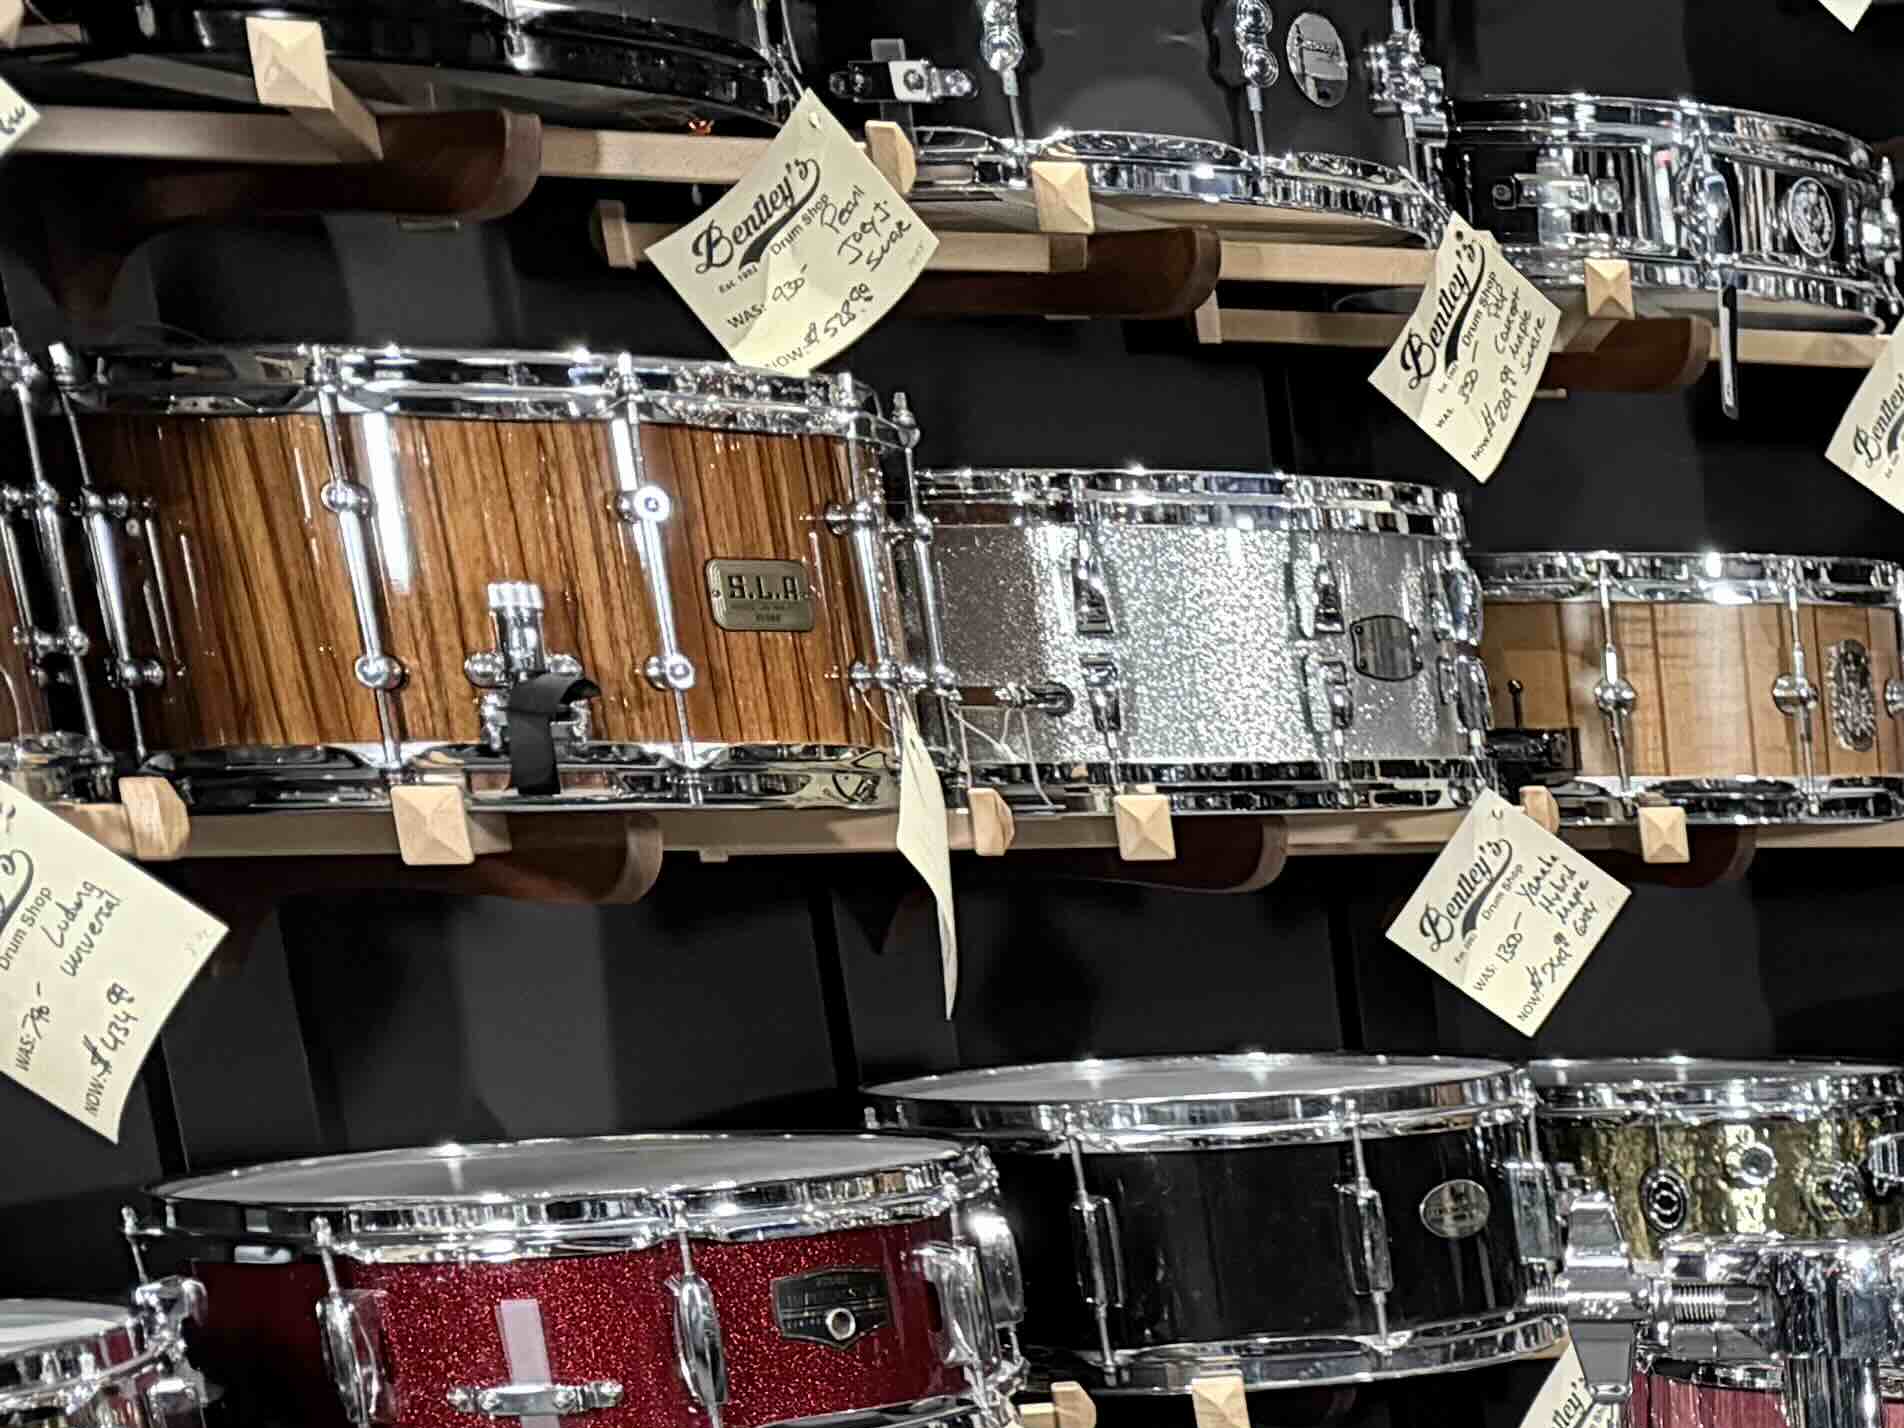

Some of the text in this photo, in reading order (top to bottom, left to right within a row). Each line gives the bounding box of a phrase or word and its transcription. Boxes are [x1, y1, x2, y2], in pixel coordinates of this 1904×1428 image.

[692, 158, 820, 274] Bentley's
[771, 194, 829, 256] Drum Shop
[1400, 240, 1486, 389] Bentley's
[22, 885, 54, 926] Shop
[1420, 838, 1513, 953] Bentley's
[15, 1031, 39, 1073] WAS:
